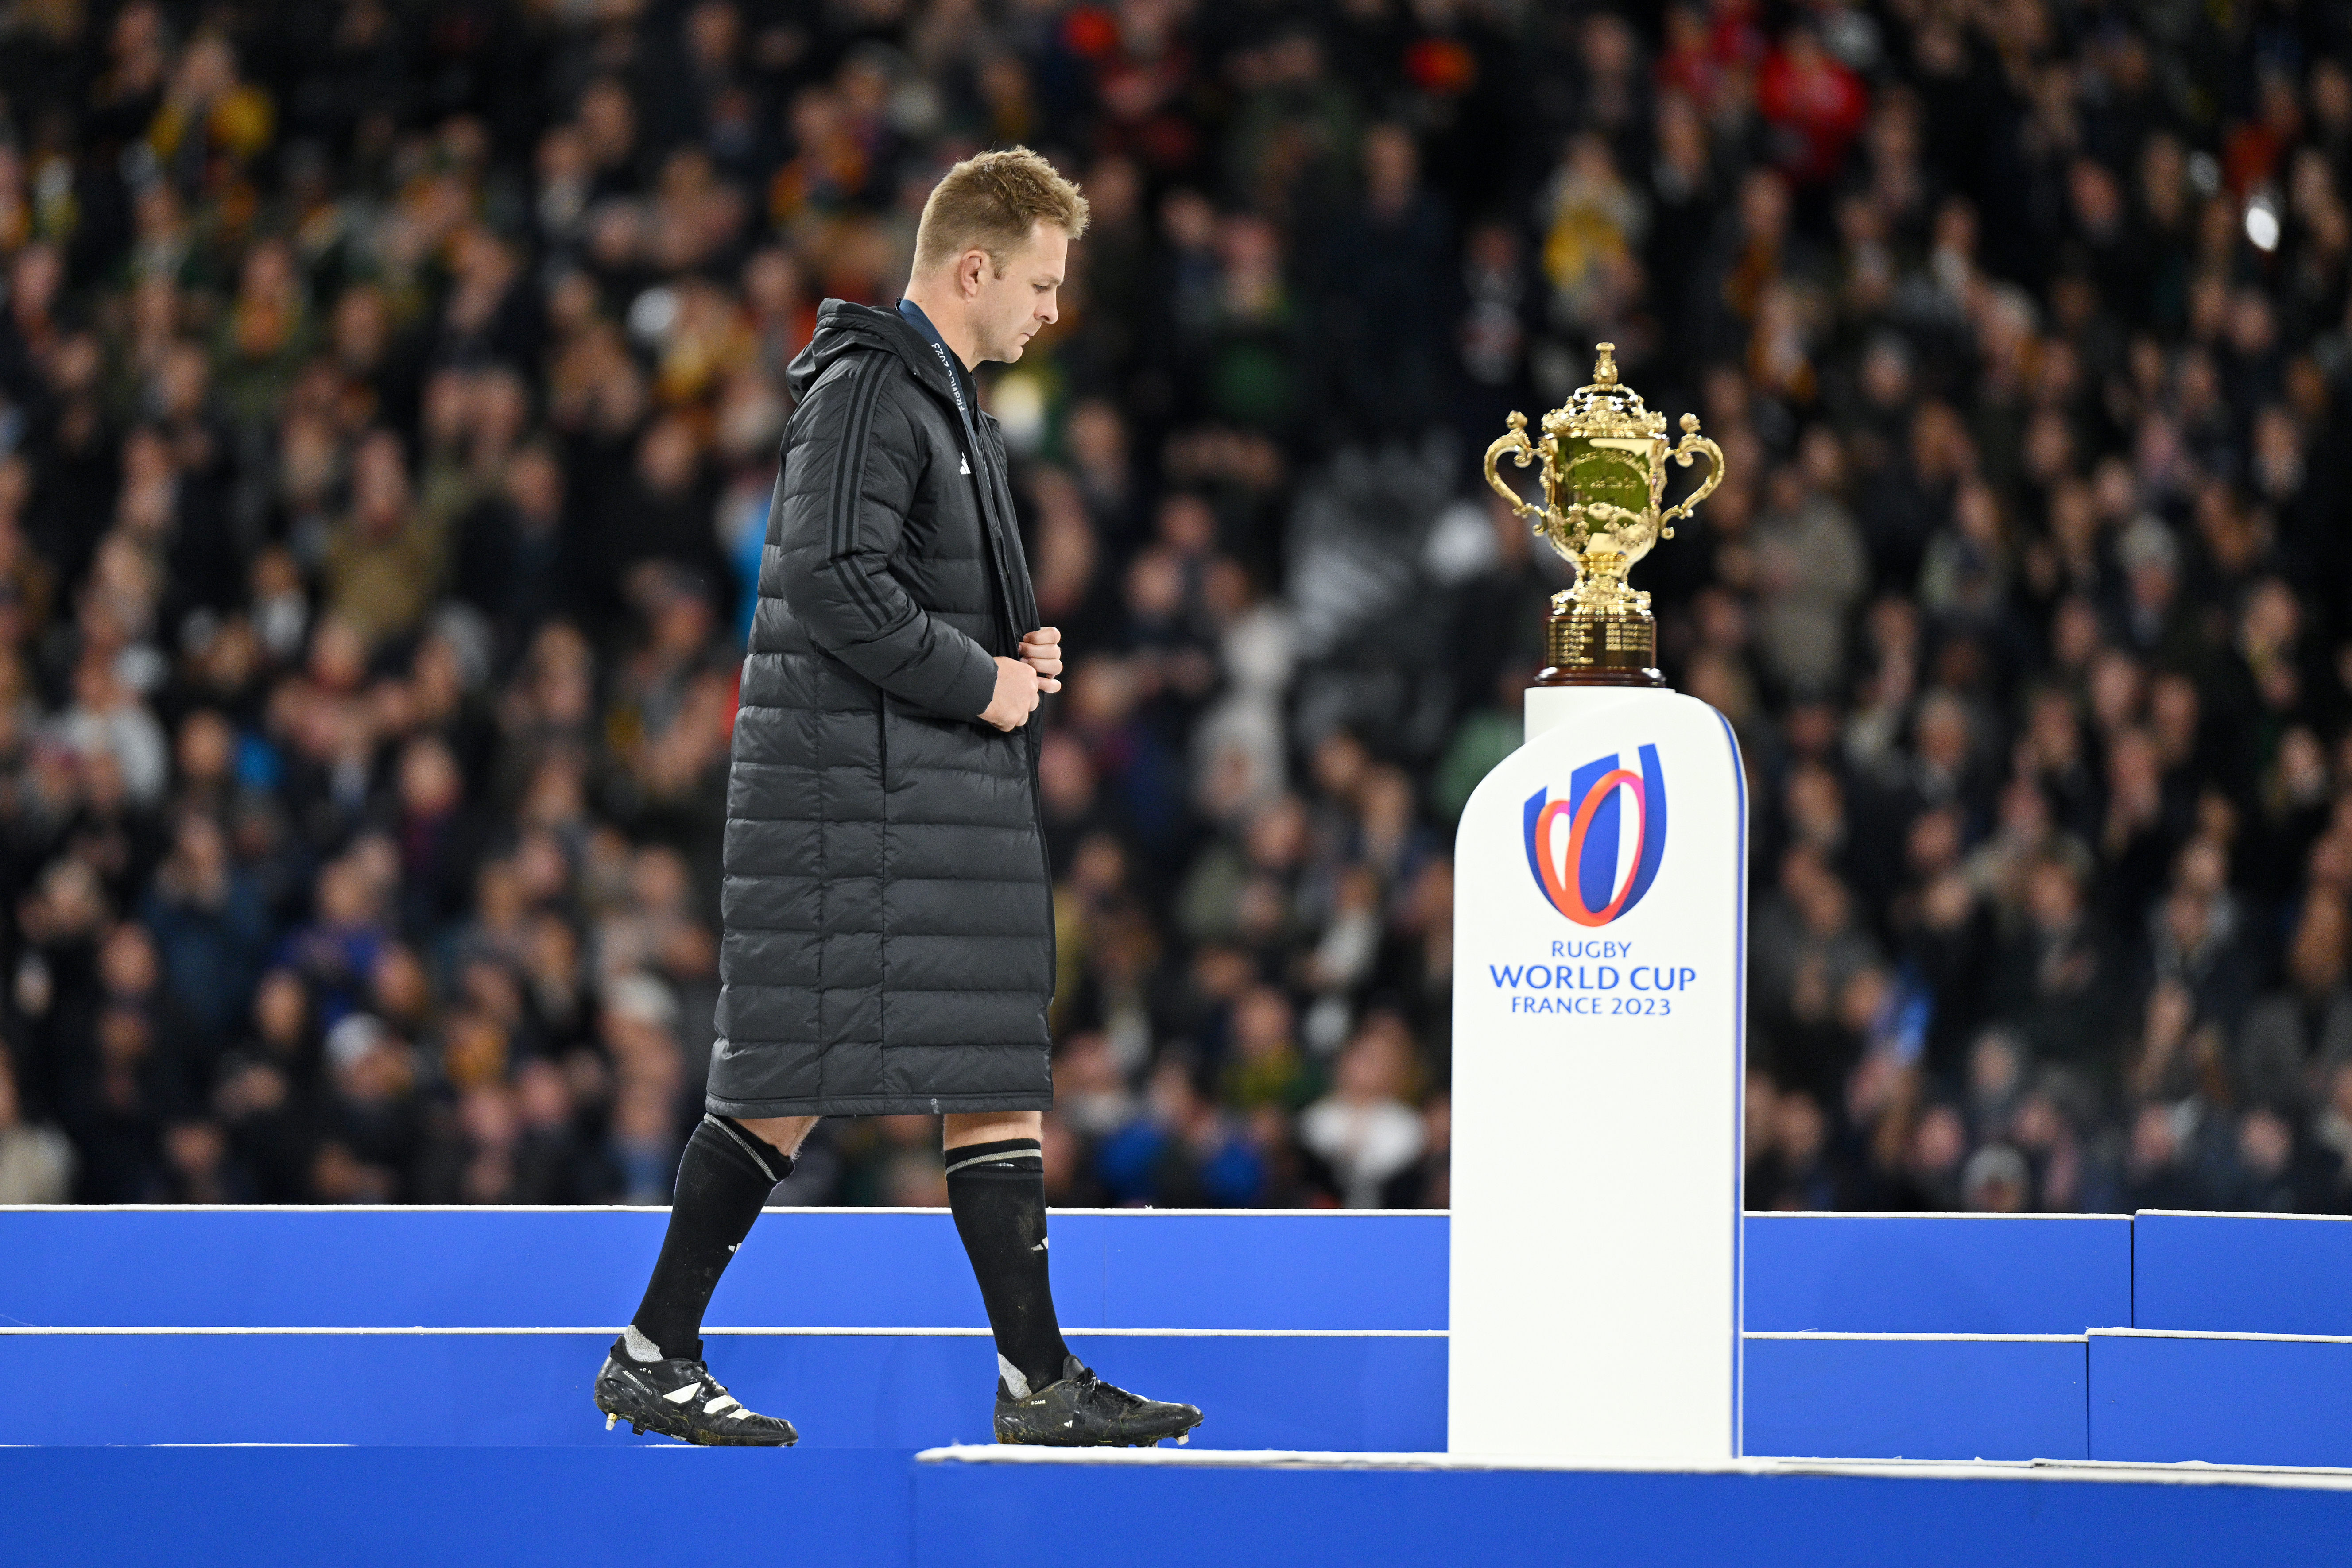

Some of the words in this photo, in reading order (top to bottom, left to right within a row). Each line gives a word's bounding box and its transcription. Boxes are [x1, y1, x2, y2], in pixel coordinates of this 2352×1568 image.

[1552, 941, 1632, 959] RUGBY
[1489, 964, 1620, 990] WORLD
[1630, 966, 1697, 991] CUP
[1512, 996, 1602, 1014] FRANCE
[1611, 997, 1671, 1016] 2023
[622, 1370, 638, 1382] ADIZERO
[644, 1386, 652, 1395] PRO
